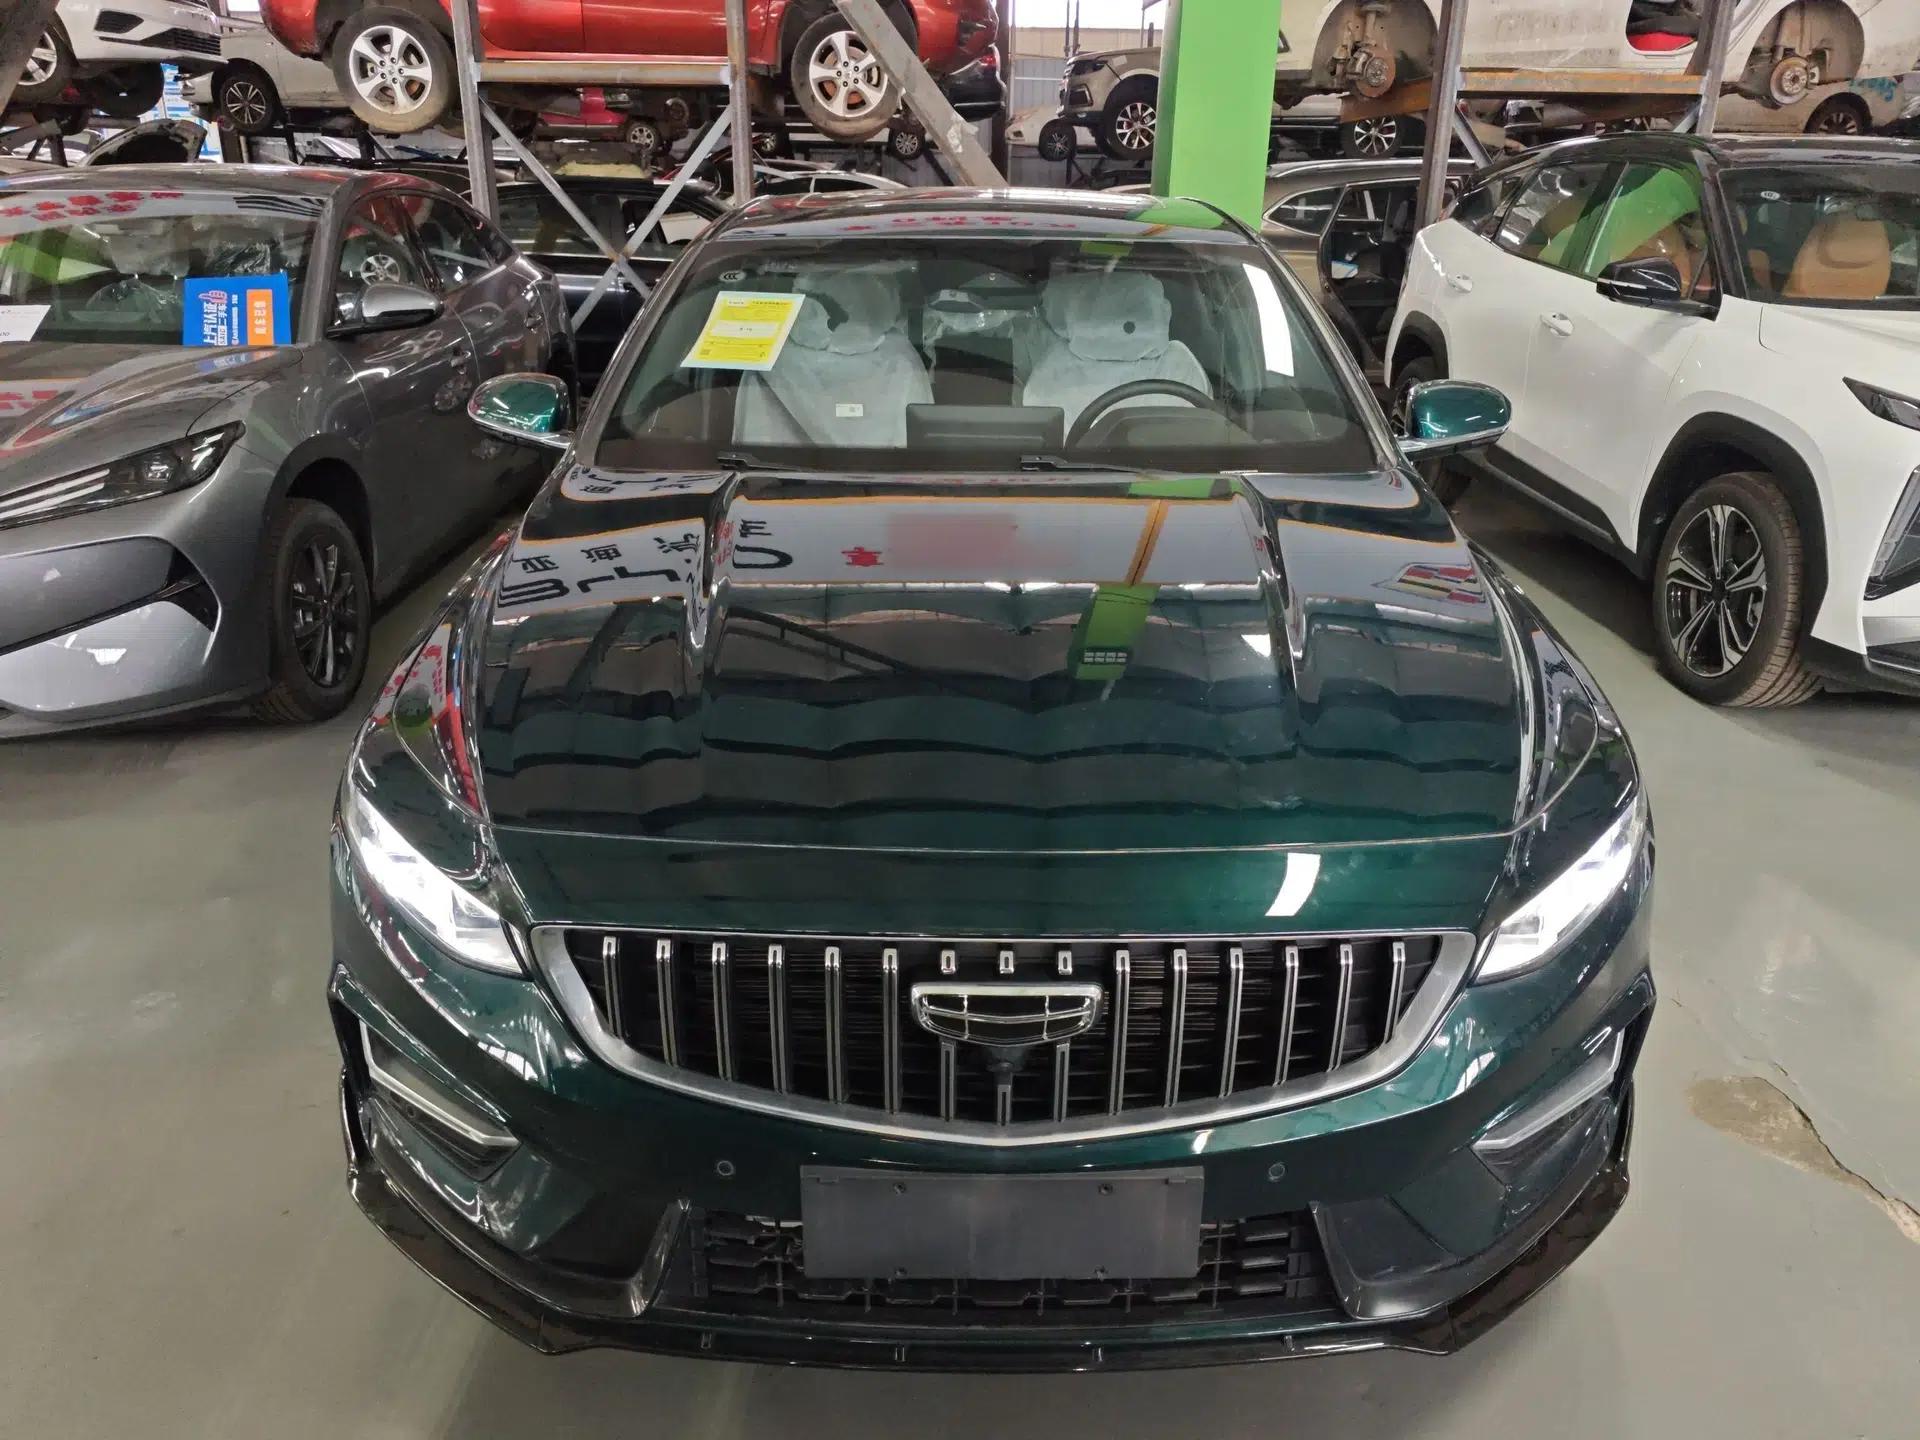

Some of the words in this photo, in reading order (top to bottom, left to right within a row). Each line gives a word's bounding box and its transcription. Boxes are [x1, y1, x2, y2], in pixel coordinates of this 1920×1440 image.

[203, 302, 217, 346] 上汽认证
[218, 303, 227, 326] 二手车
